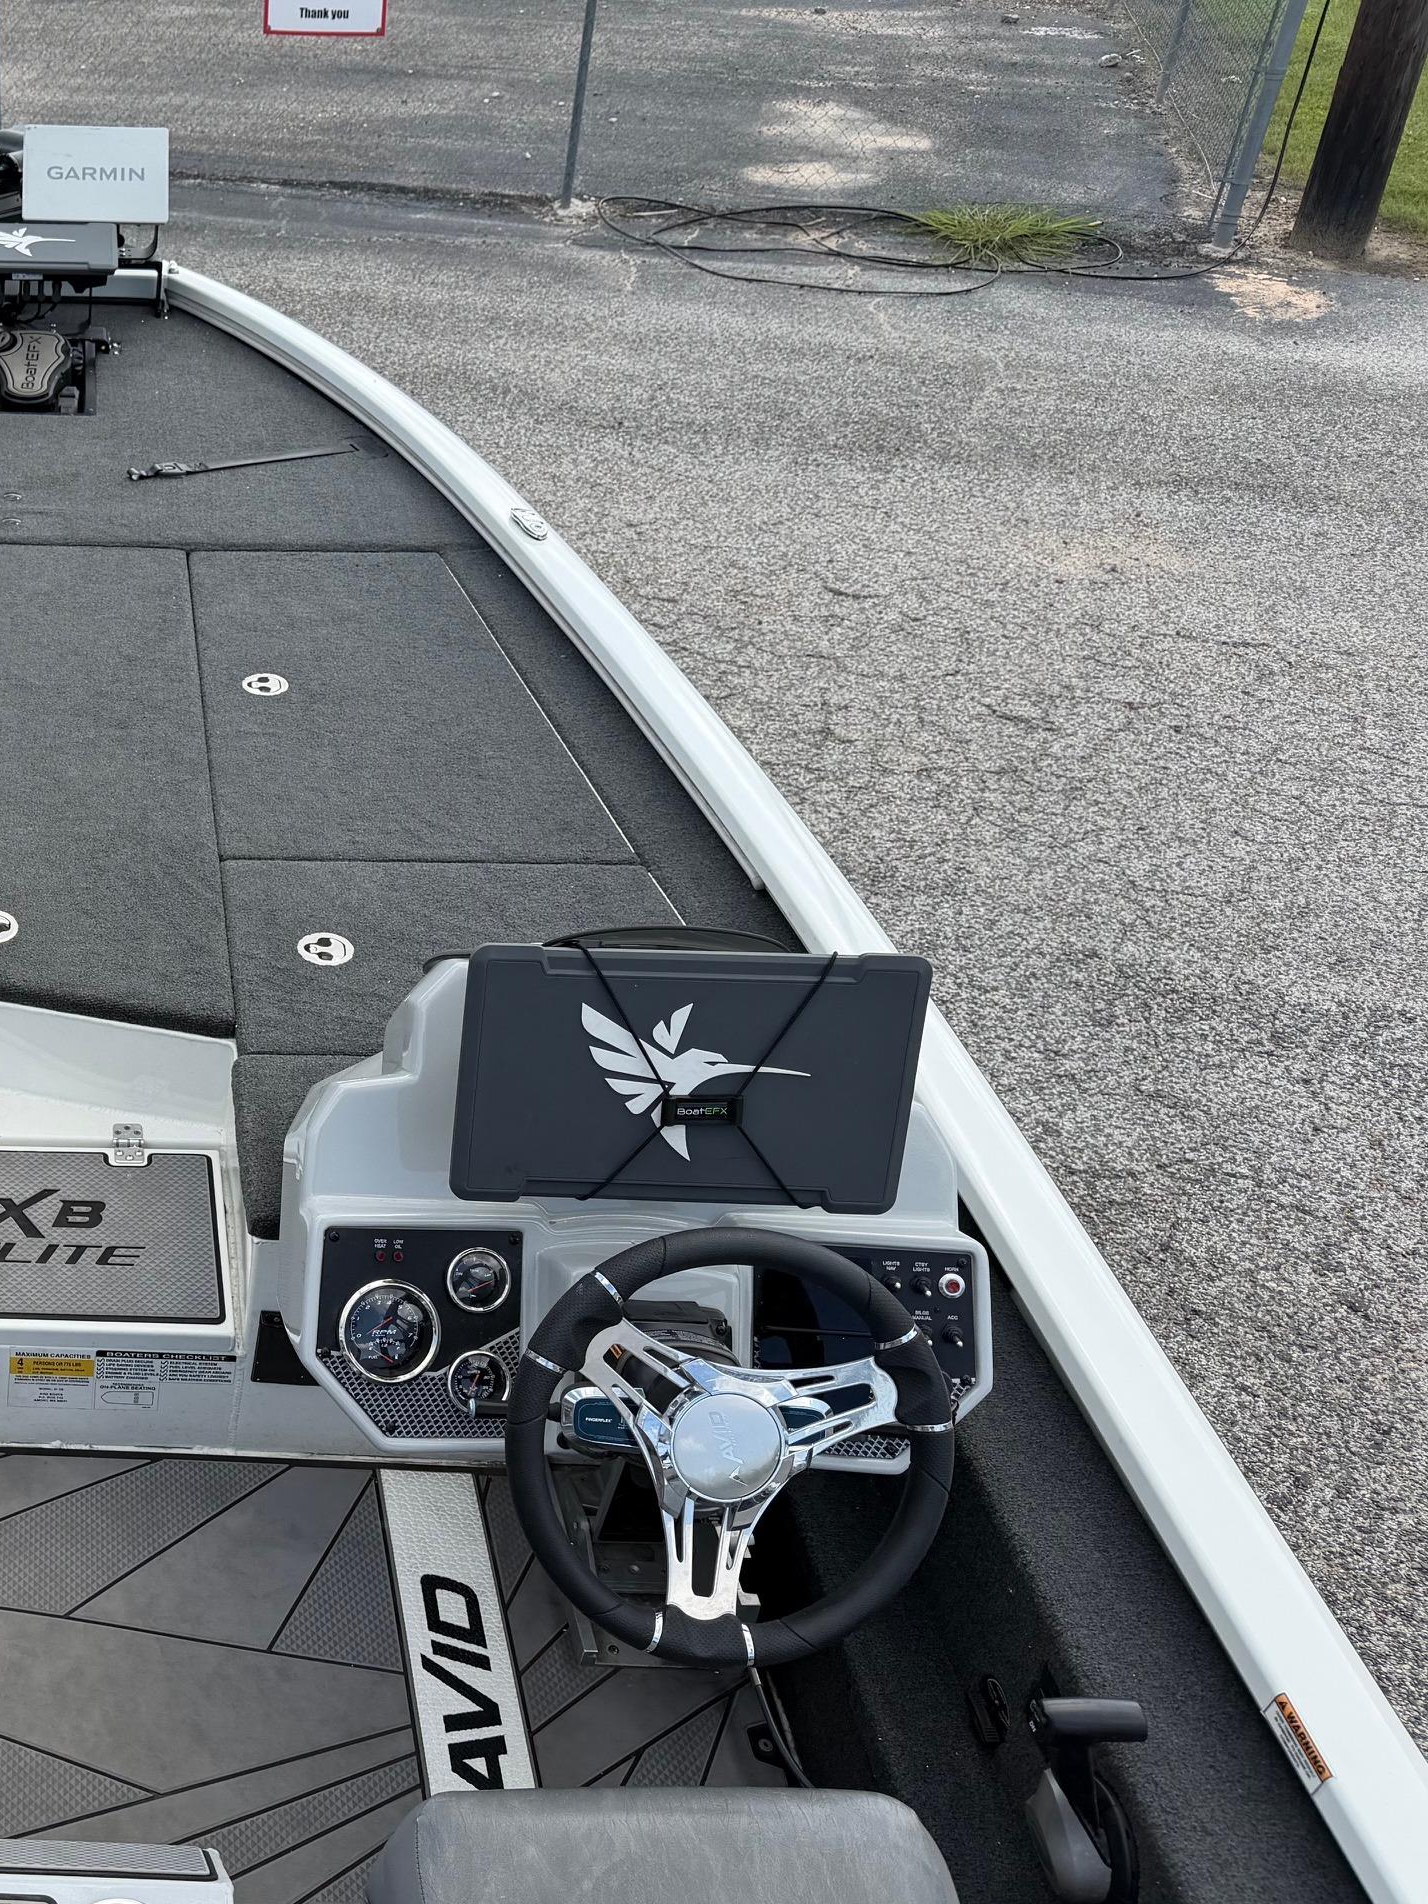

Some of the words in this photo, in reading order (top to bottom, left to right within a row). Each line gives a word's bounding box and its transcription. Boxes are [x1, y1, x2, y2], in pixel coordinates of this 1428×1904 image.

[299, 7, 329, 19] Thank
[331, 9, 350, 20] you
[46, 165, 146, 182] GARMIN
[20, 336, 42, 390] BoatEFX
[676, 1106, 728, 1116] BoatEFX
[17, 1357, 24, 1367] 4
[162, 1353, 227, 1361] CHECKLIST
[420, 1573, 508, 1791] AVID
[1286, 1711, 1326, 1775] WARNING
